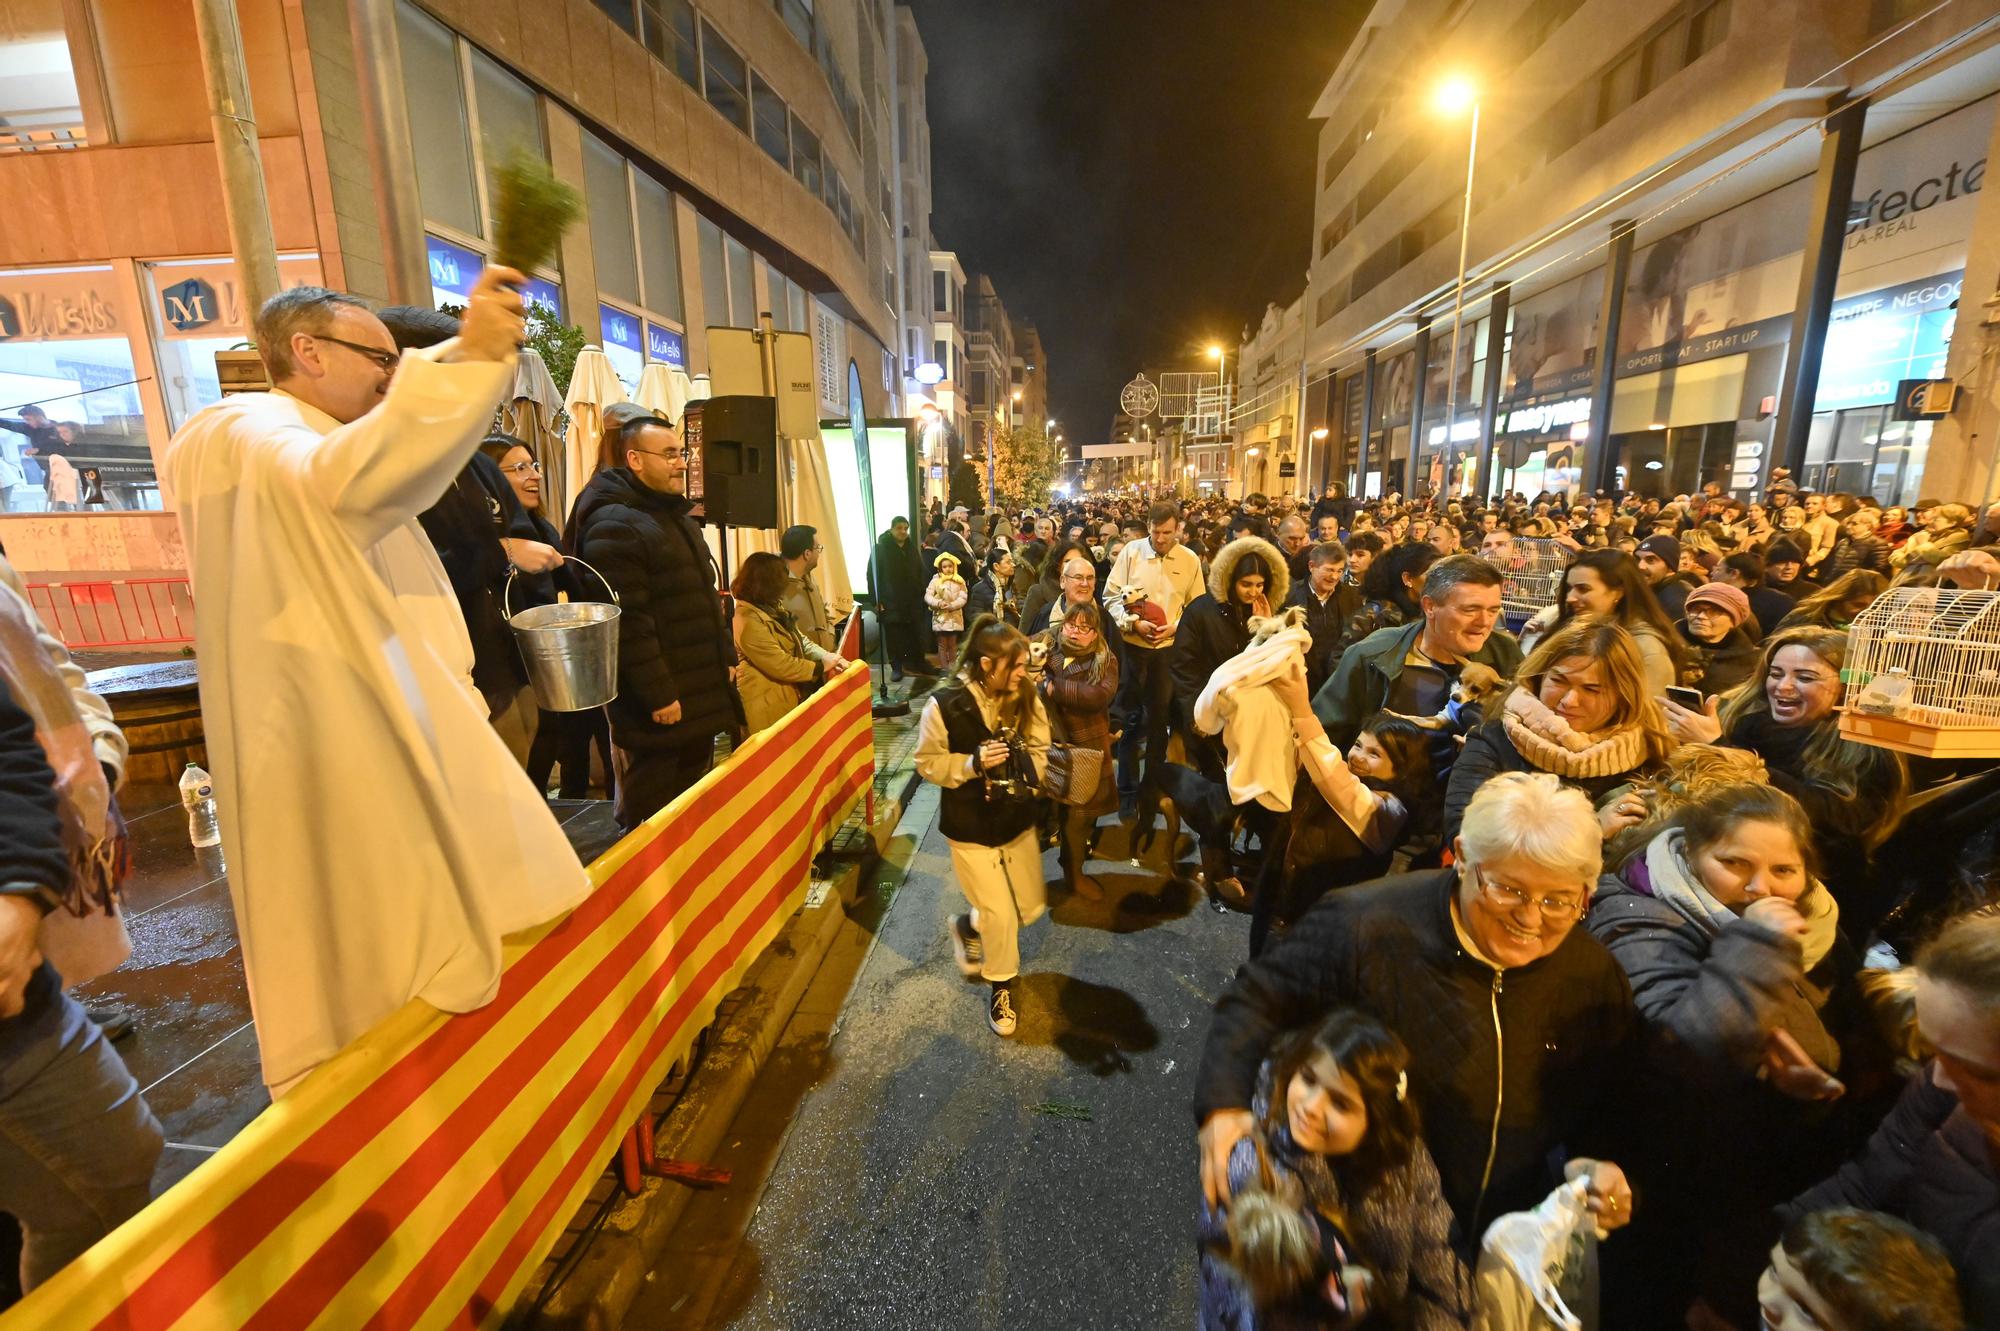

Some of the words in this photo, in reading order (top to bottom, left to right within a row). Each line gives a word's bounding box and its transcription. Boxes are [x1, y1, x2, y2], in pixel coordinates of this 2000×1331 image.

[1848, 216, 1918, 250] LA-REAL
[1829, 298, 1886, 324] ENTRE
[1704, 337, 1740, 353] START
[1741, 329, 1760, 344] UP
